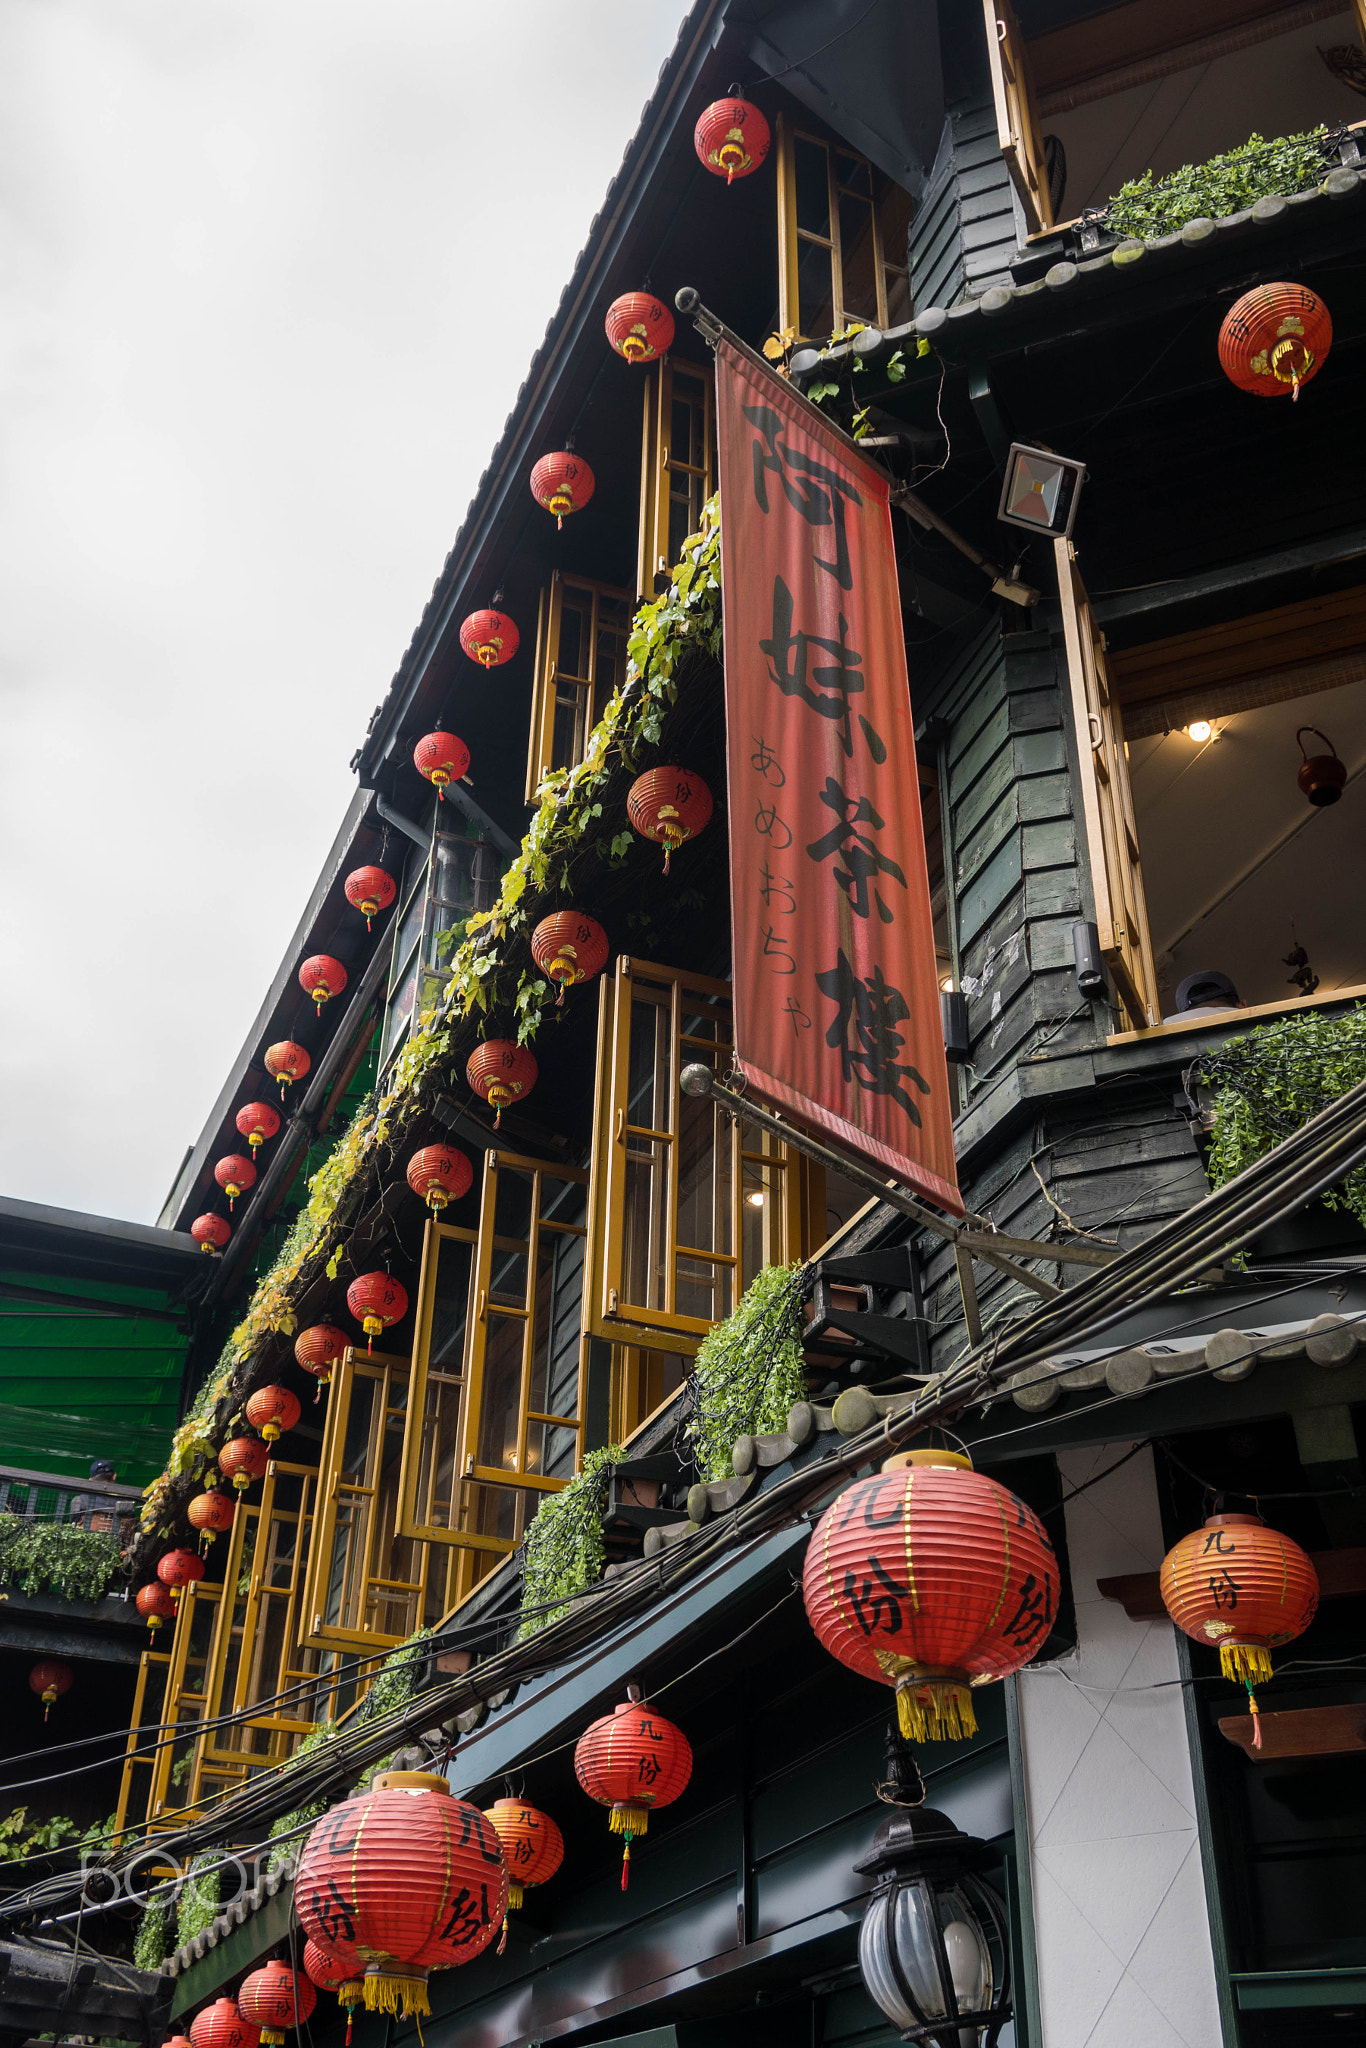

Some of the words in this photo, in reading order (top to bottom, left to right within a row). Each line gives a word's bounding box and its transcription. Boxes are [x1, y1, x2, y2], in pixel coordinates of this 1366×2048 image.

[384, 1276, 397, 1305] 九份
[323, 1326, 336, 1353] 九份
[275, 1388, 286, 1414] 九份
[838, 1477, 910, 1637] 九份
[1203, 1530, 1243, 1610] 九份
[638, 1720, 662, 1786] 九份
[514, 1810, 539, 1864] 九份
[312, 1807, 357, 1942] 九份
[440, 1806, 500, 1946] 九份
[276, 1976, 293, 2018] 九份
